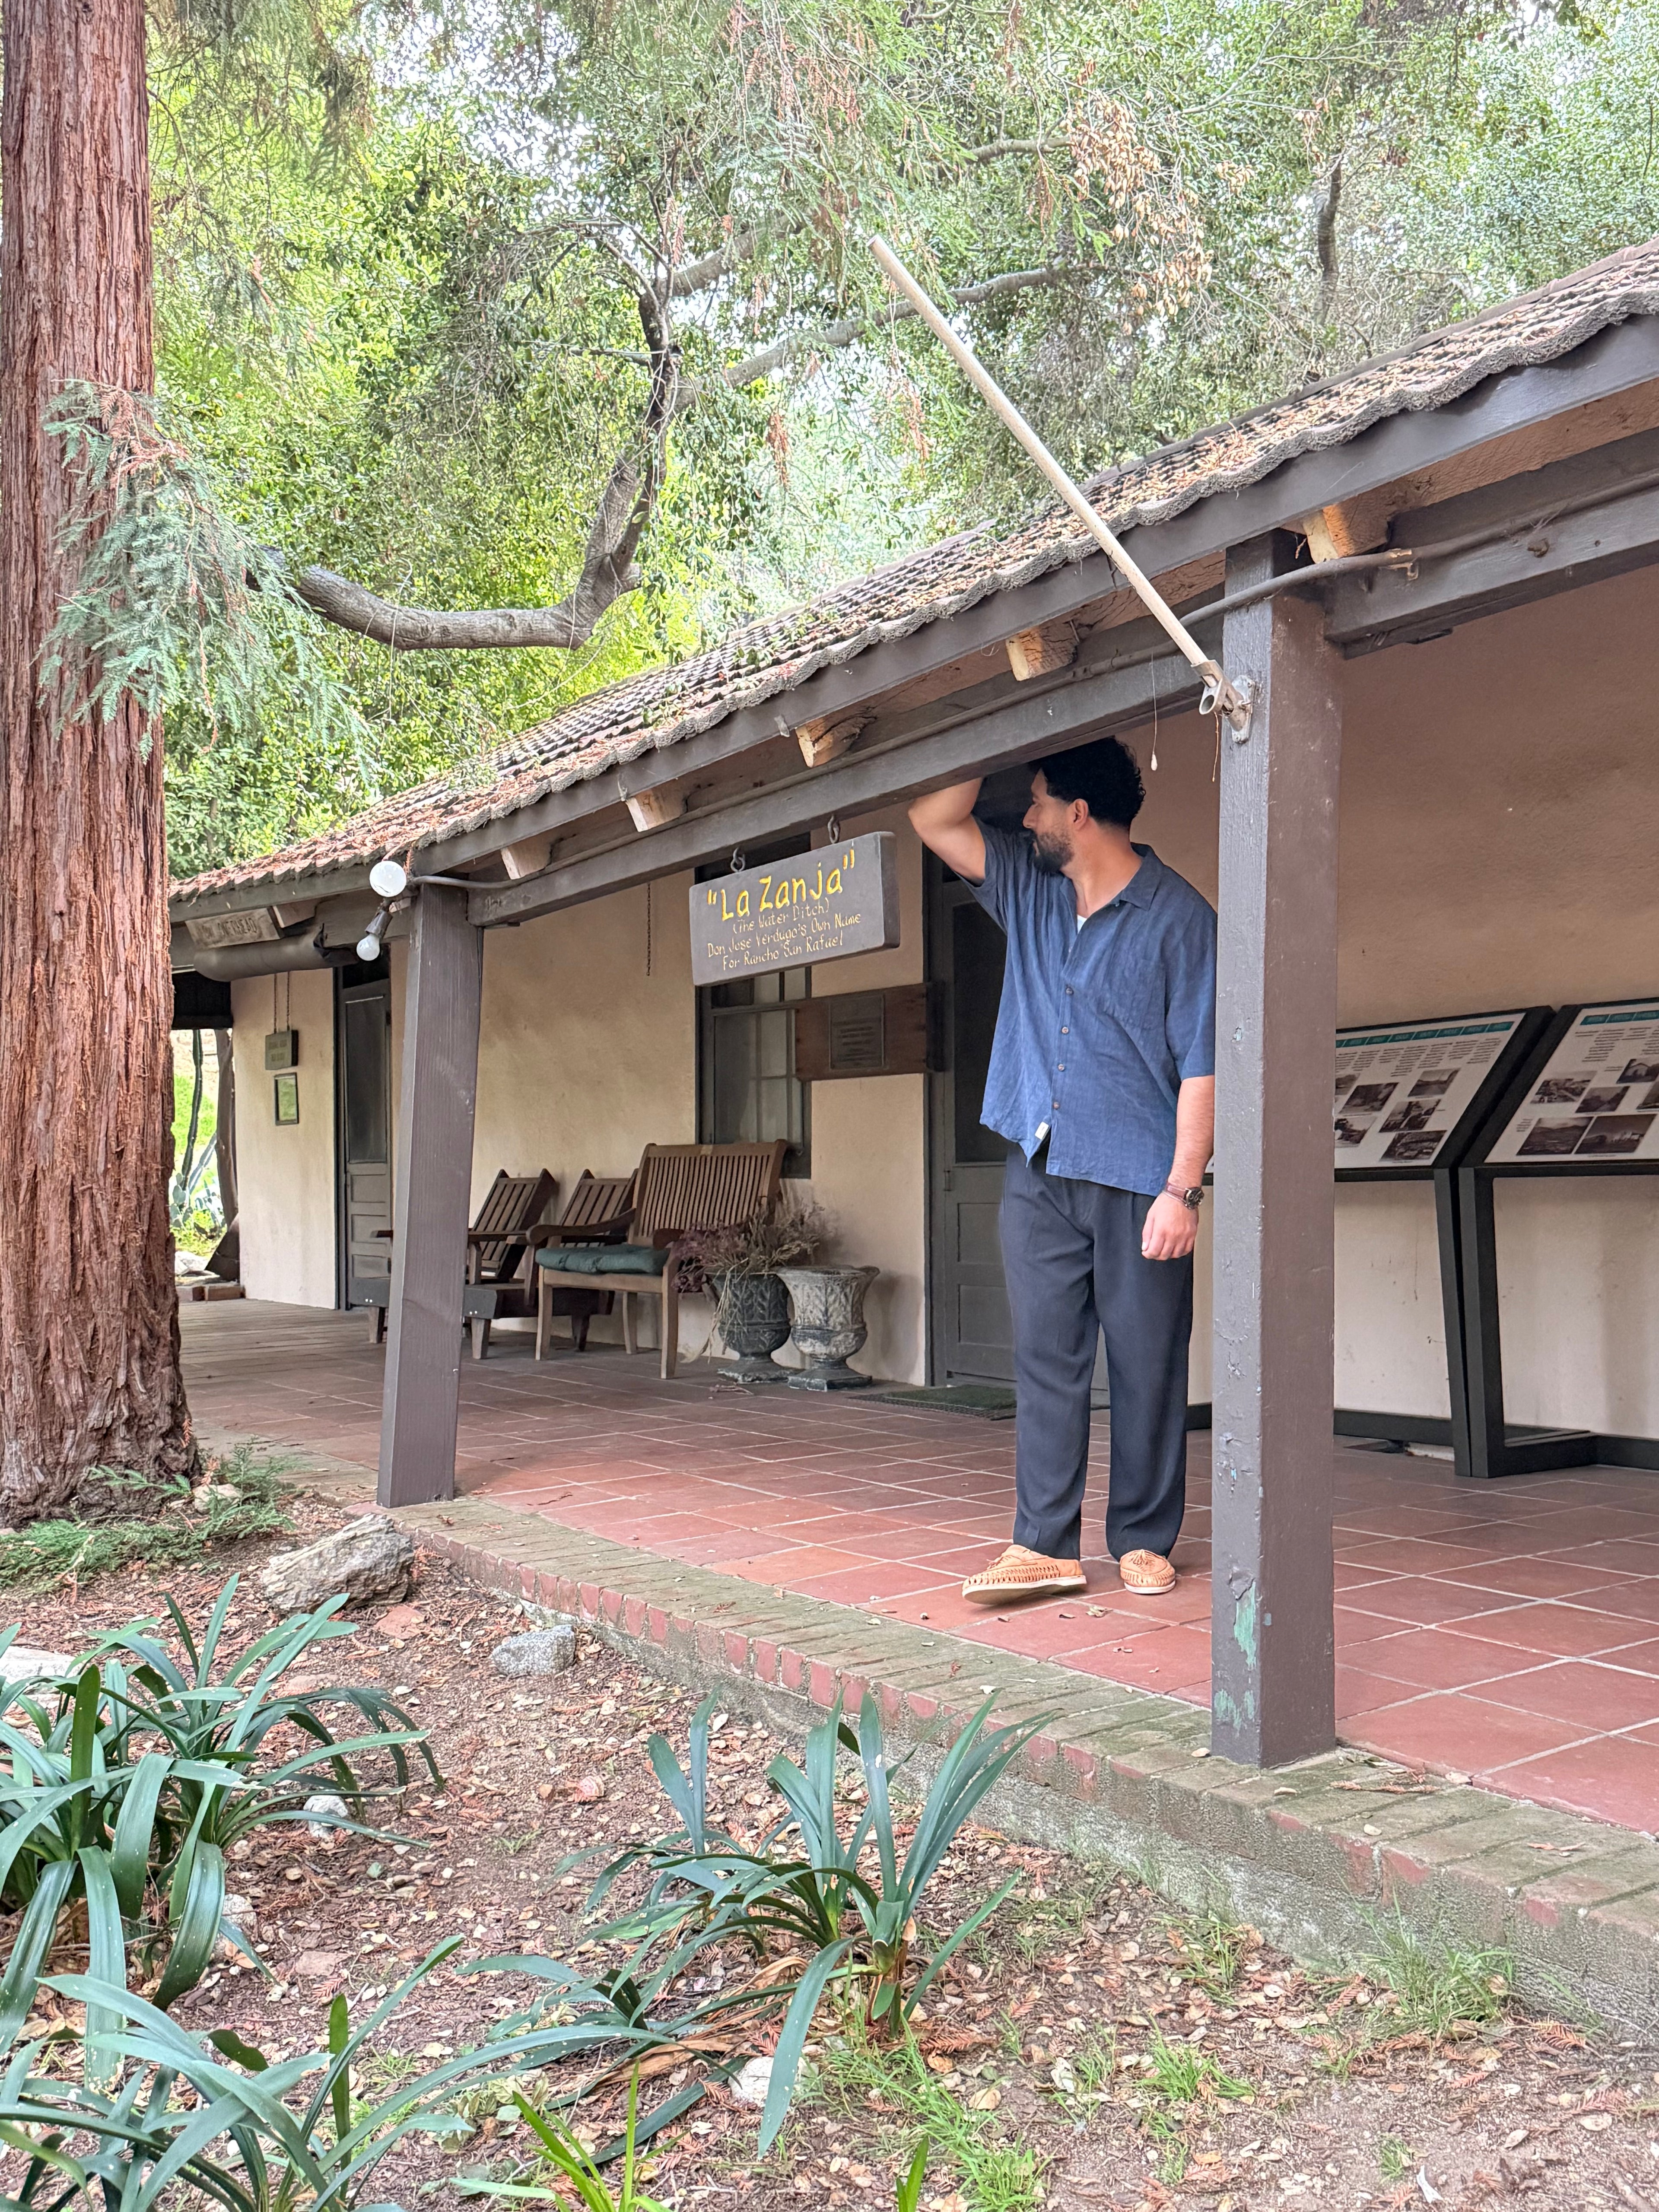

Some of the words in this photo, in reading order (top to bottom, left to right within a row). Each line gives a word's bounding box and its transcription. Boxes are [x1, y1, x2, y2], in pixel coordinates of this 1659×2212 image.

[707, 889, 750, 921] "La
[760, 849, 855, 912] Zanja"
[707, 943, 725, 958] Don
[756, 924, 807, 947] Verdugo's
[811, 917, 830, 933] Own
[835, 912, 861, 929] Name
[733, 919, 755, 934] (The
[759, 912, 789, 928] Water
[793, 897, 830, 921] Ditch)
[723, 955, 740, 970] For
[744, 947, 779, 966] Rancho
[783, 939, 802, 958] San
[806, 930, 843, 953] Rafael
